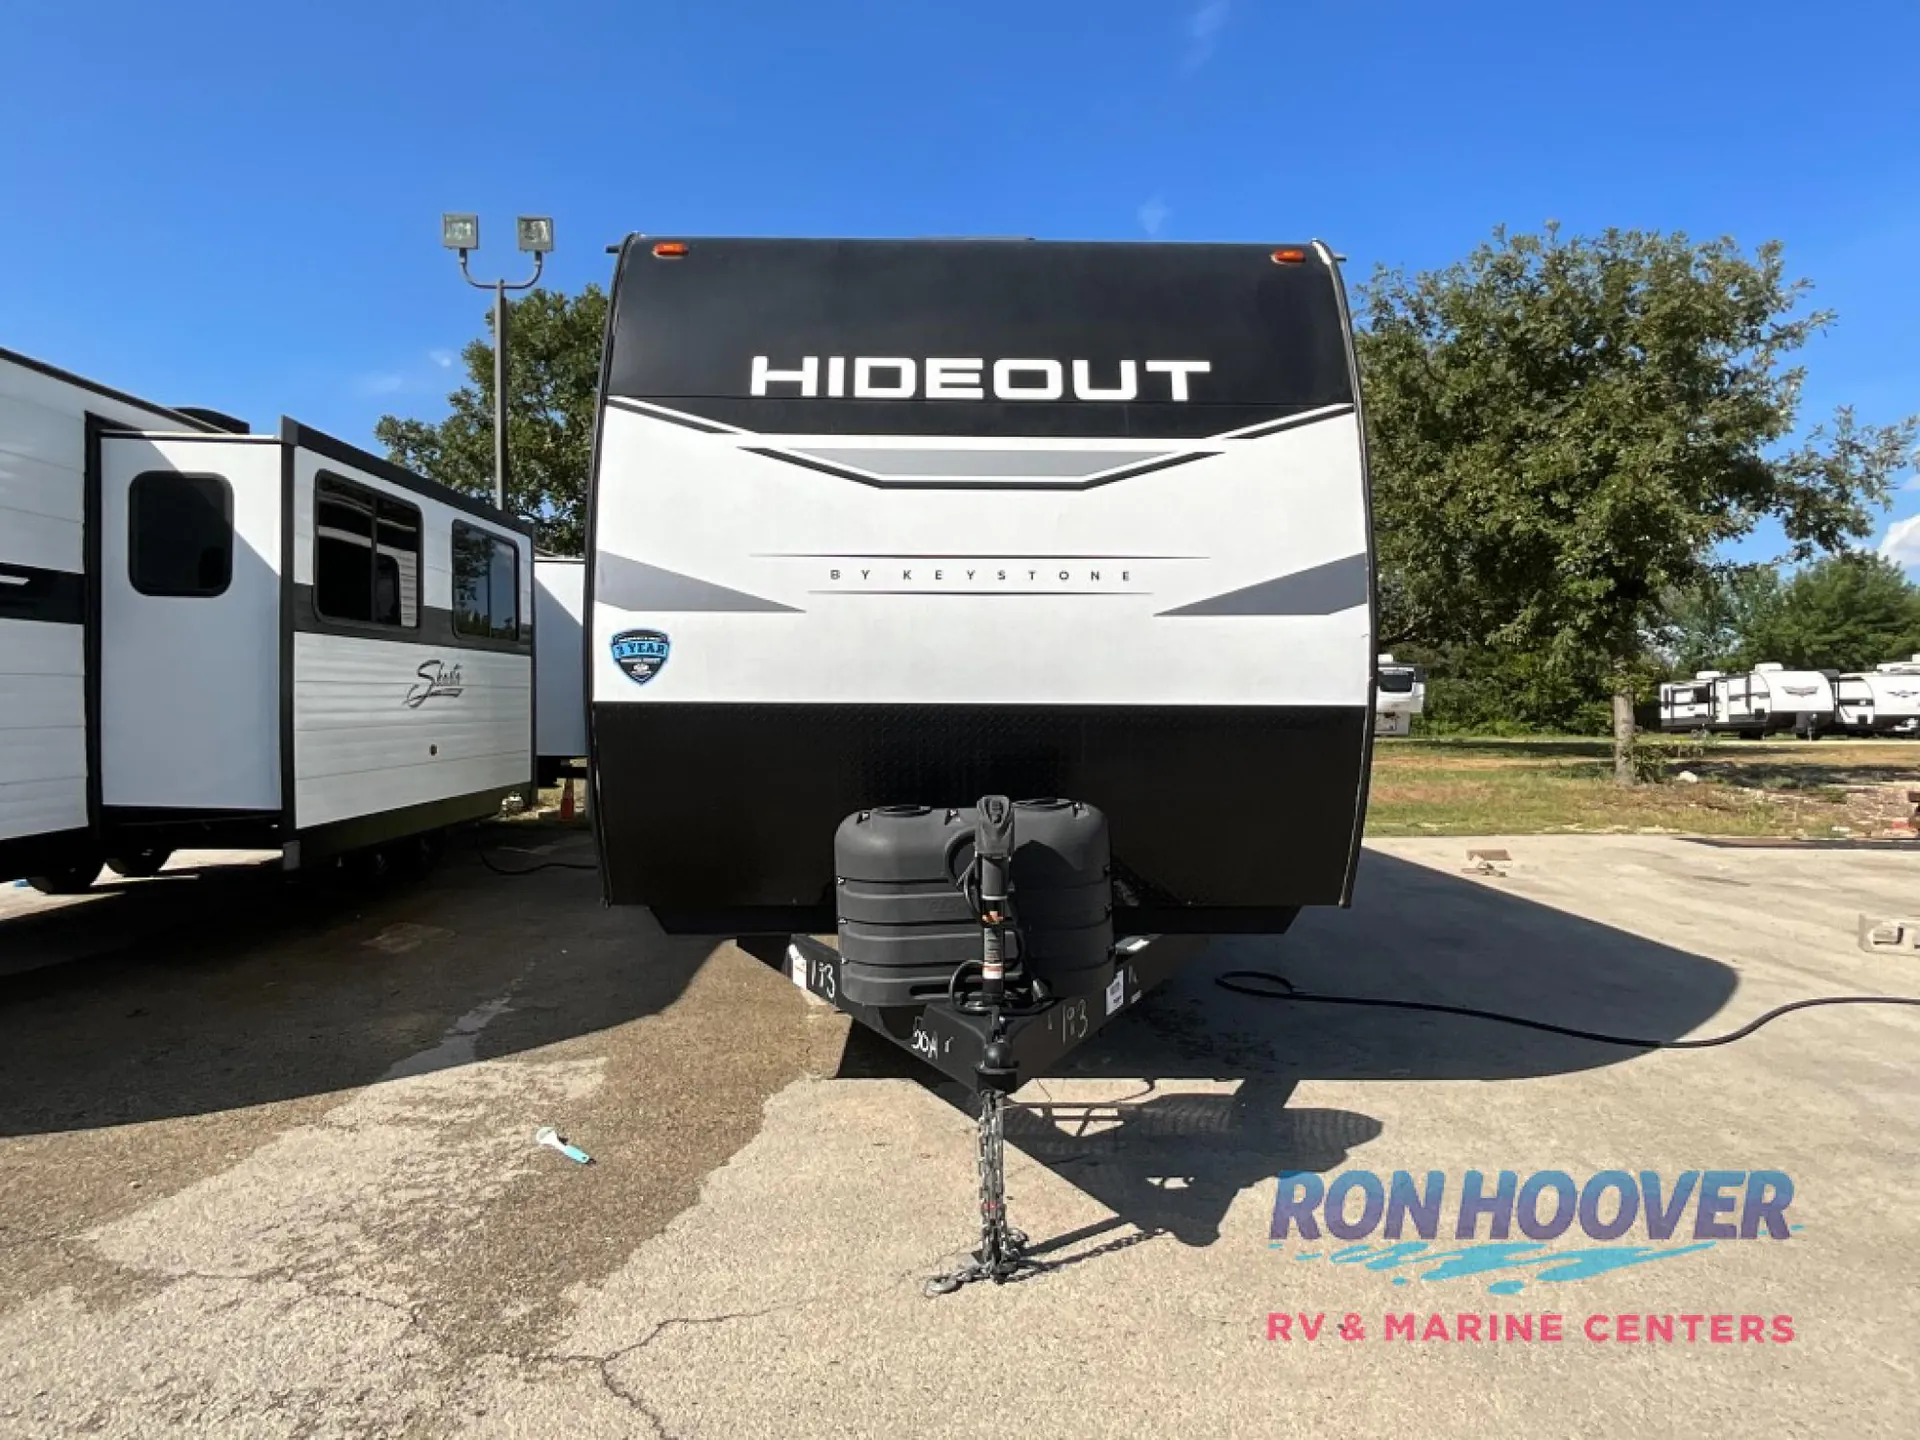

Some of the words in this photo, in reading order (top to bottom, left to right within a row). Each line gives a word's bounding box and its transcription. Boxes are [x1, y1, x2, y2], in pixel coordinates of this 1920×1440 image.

[749, 355, 1212, 402] HIDEOUT
[830, 569, 871, 581] BY
[902, 569, 1132, 582] KEYSTONE
[627, 642, 665, 655] YEAR
